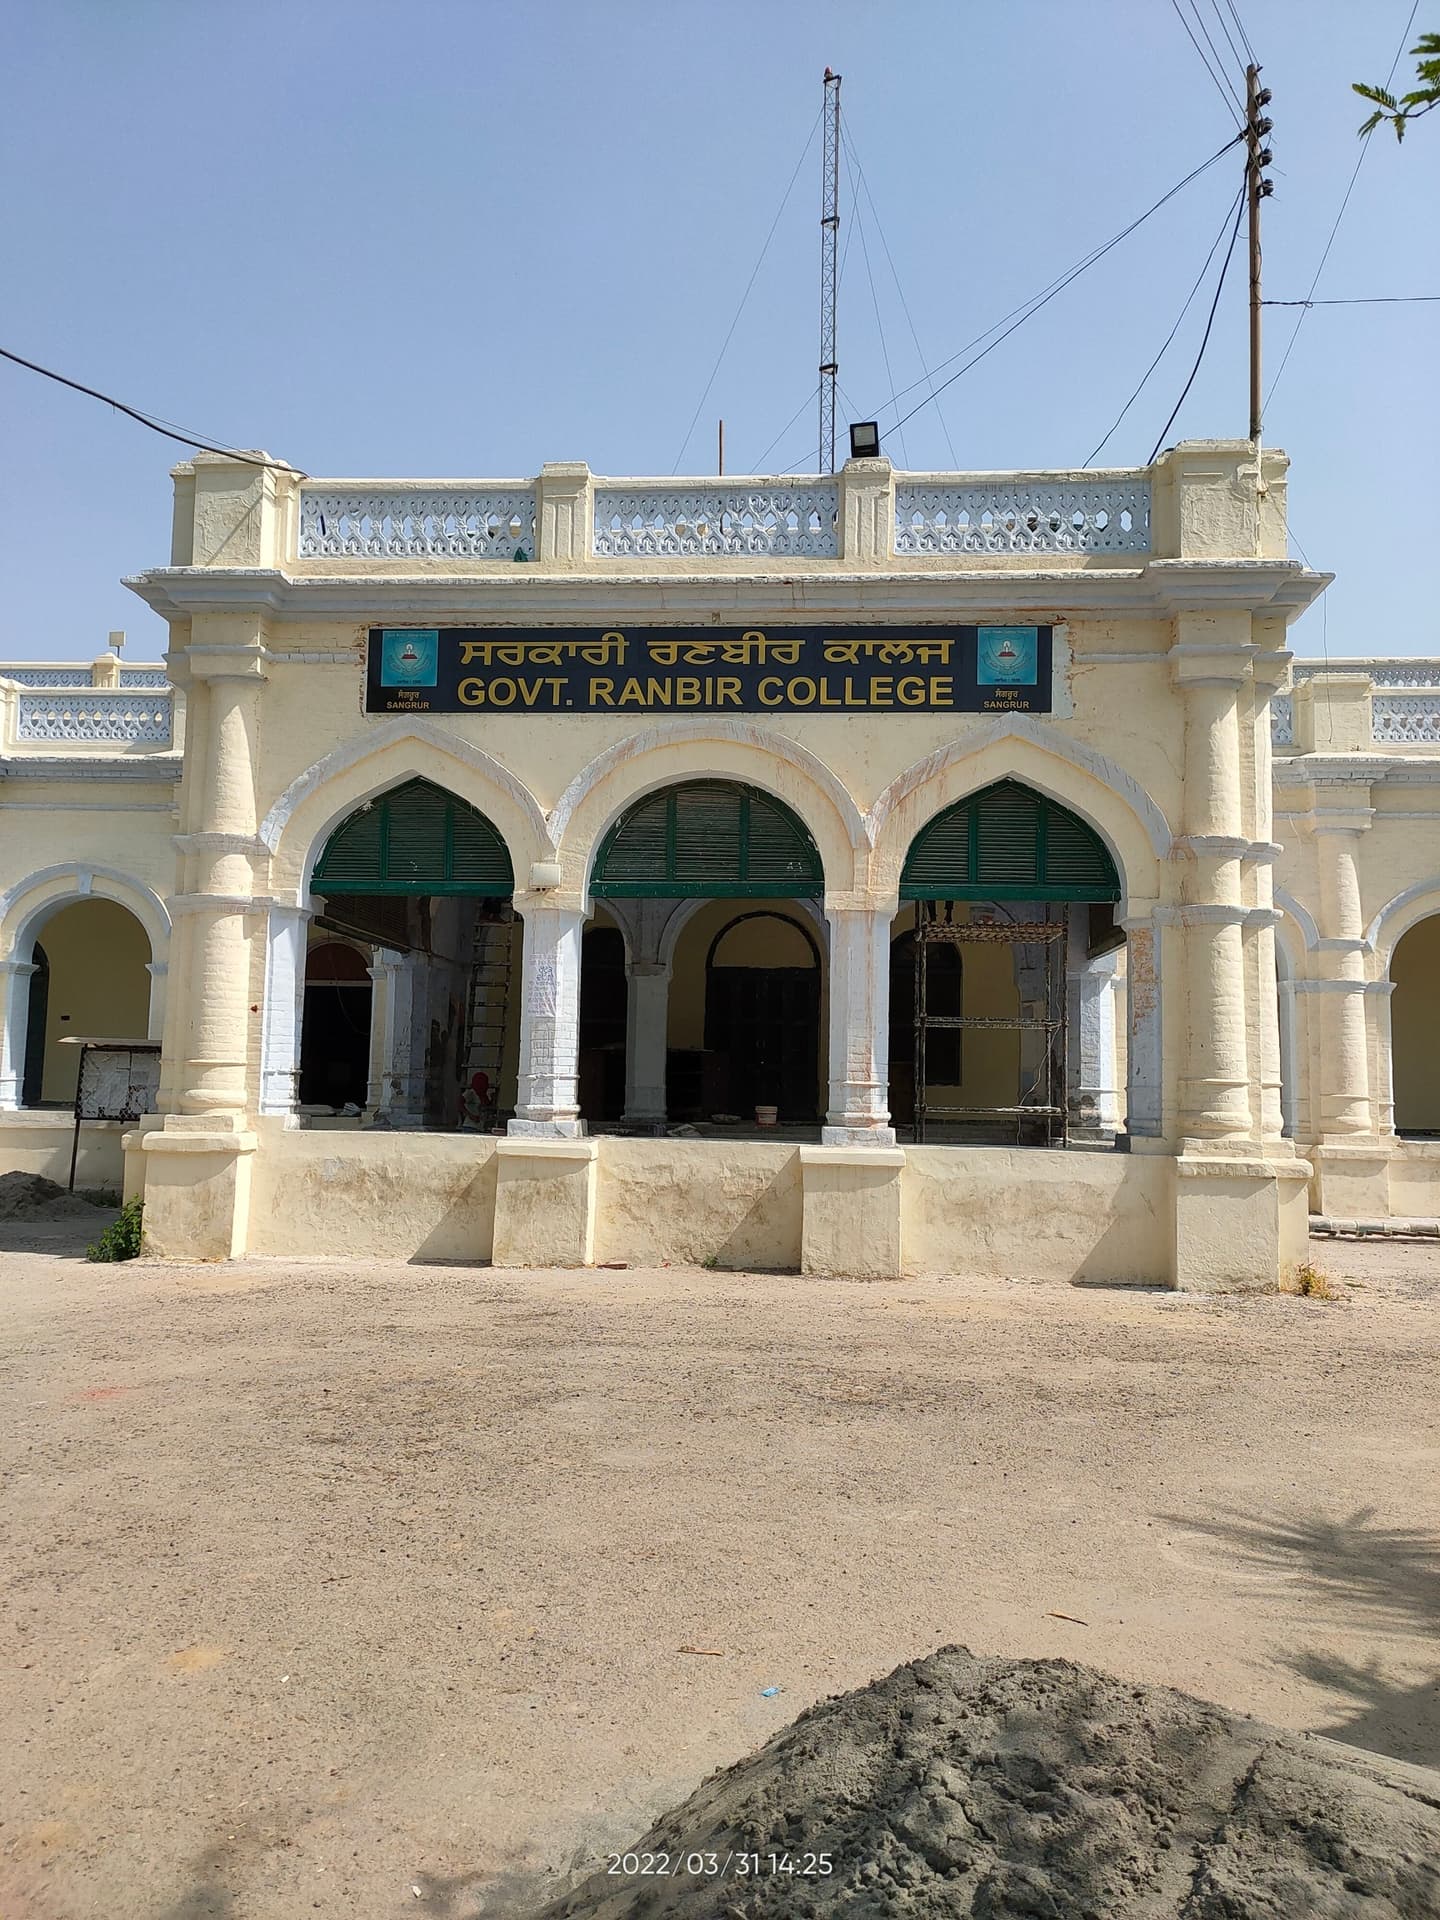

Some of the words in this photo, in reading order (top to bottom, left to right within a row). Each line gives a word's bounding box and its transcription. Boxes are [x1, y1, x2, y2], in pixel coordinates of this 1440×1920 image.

[458, 631, 630, 666] ਸਰਕਾਰੀ
[646, 630, 806, 666] ਰਣਬੀਰ
[822, 639, 956, 665] ਕਾਲਜ
[457, 676, 573, 706] GOVT.
[588, 676, 744, 706] RANBIR
[757, 675, 955, 706] COLLEGE
[386, 701, 430, 710] SANGRUR
[983, 700, 1030, 709] SANGRUR
